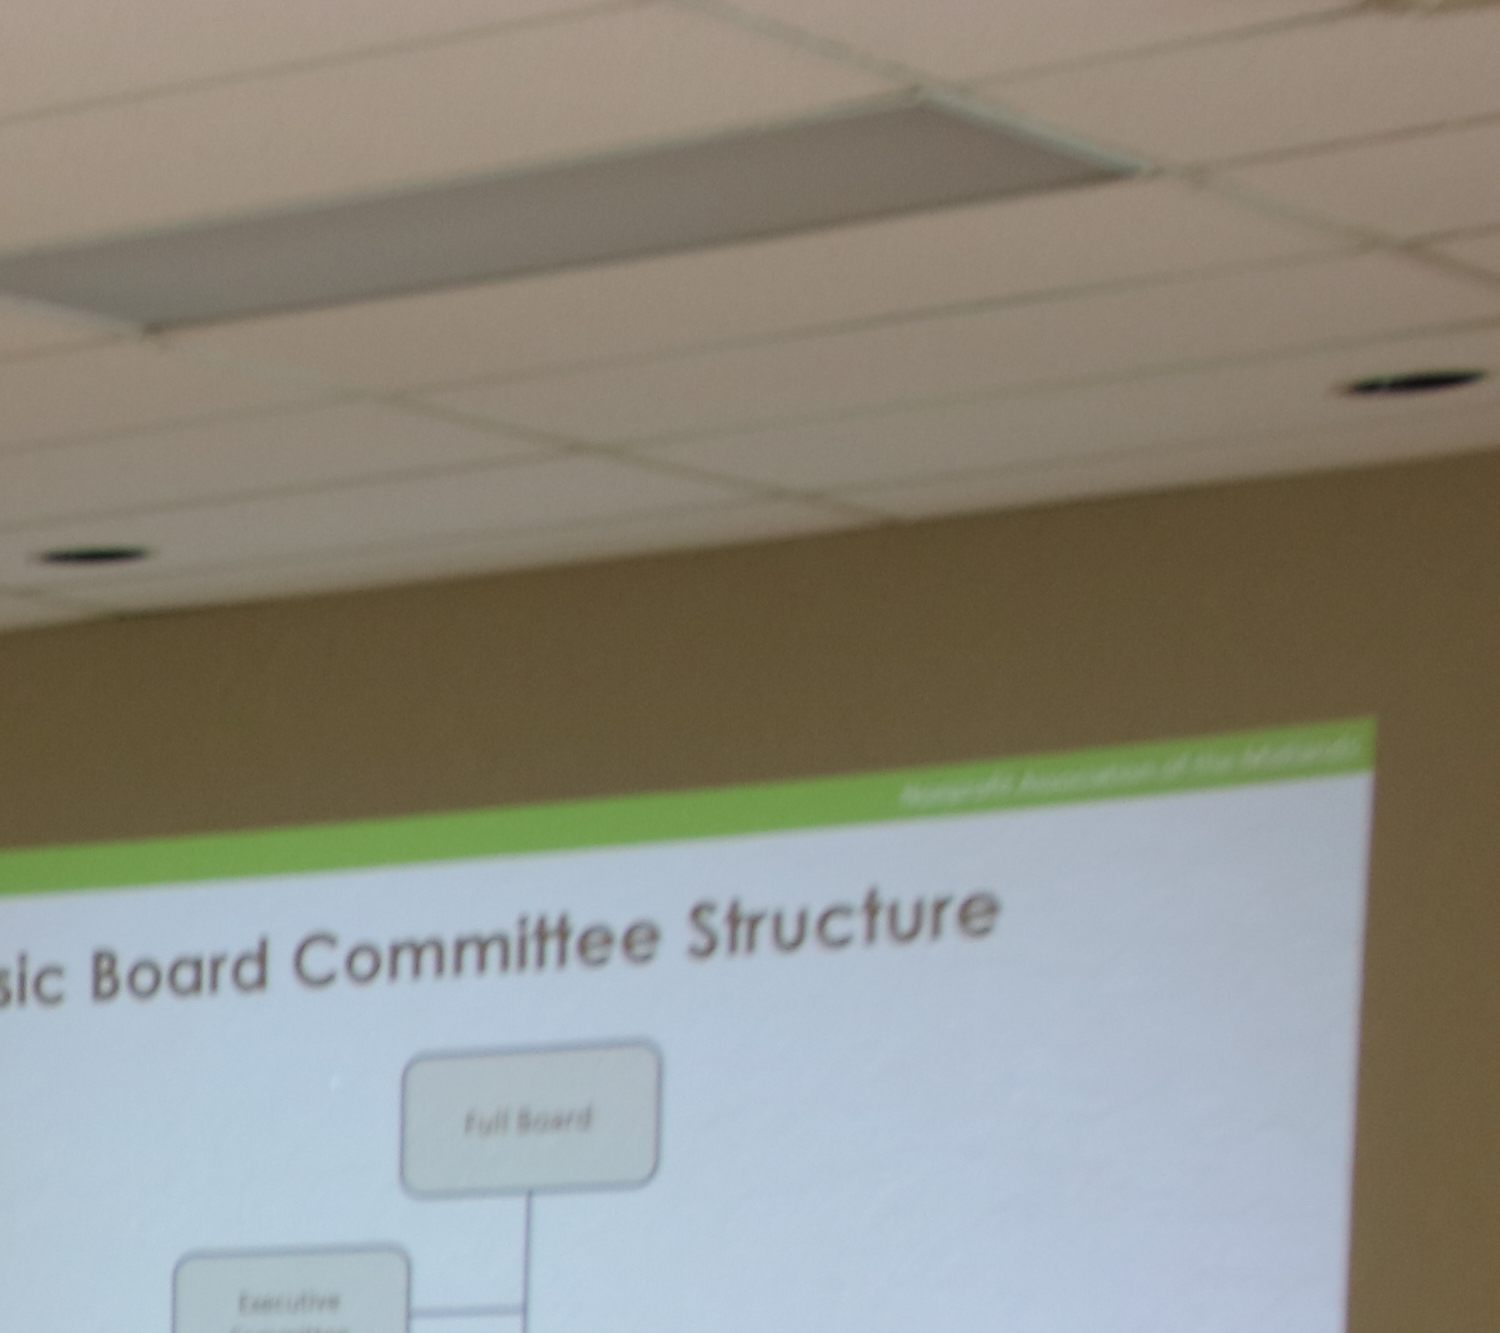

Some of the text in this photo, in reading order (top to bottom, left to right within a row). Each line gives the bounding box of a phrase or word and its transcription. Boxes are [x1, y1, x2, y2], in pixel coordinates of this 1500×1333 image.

[92, 936, 270, 1002] Board
[293, 912, 661, 988] Committee
[687, 885, 999, 958] Structure
[464, 1103, 593, 1138] Full Board
[238, 1290, 341, 1316] Executive
